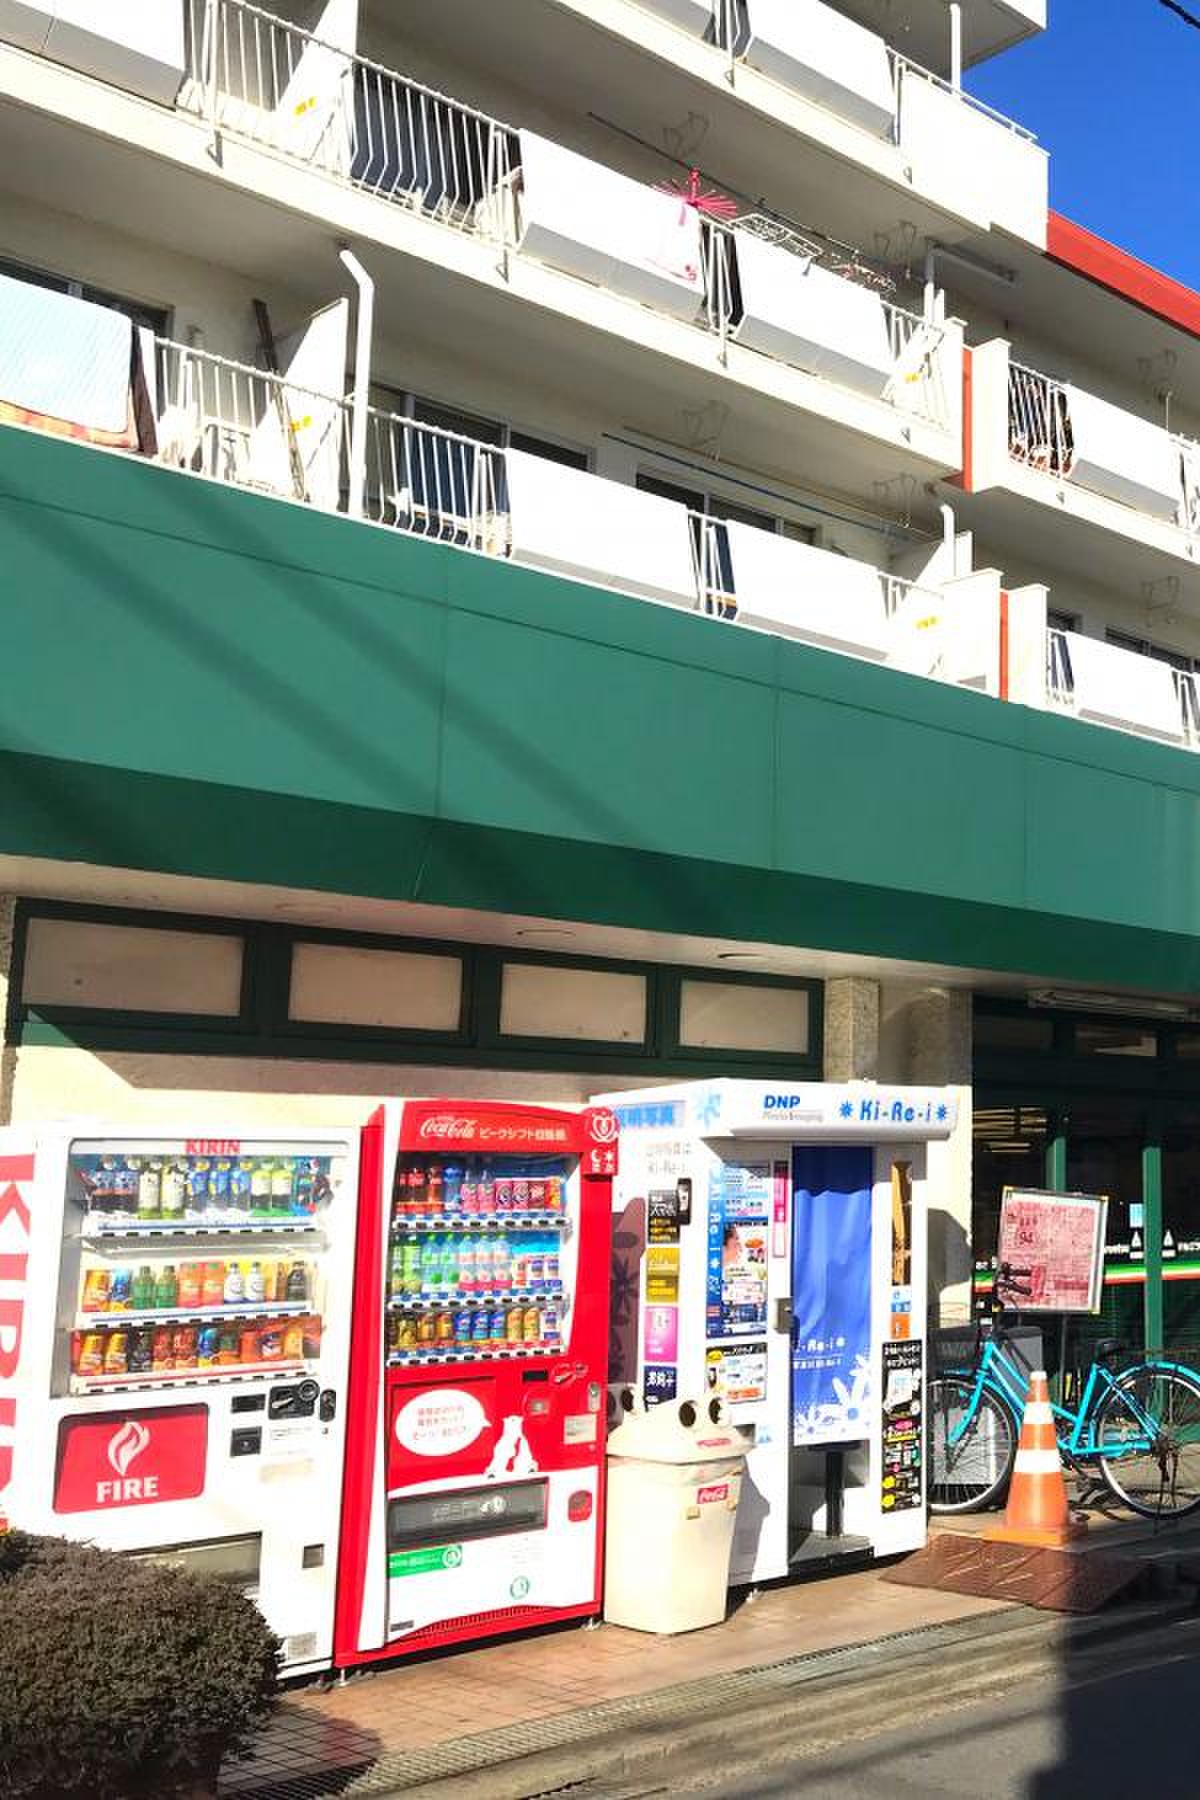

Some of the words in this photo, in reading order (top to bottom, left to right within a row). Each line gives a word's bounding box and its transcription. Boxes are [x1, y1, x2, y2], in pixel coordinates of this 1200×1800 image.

[763, 1095, 800, 1109] DNP
[186, 1138, 240, 1153] KIRIN
[96, 1476, 159, 1504] FIRE
